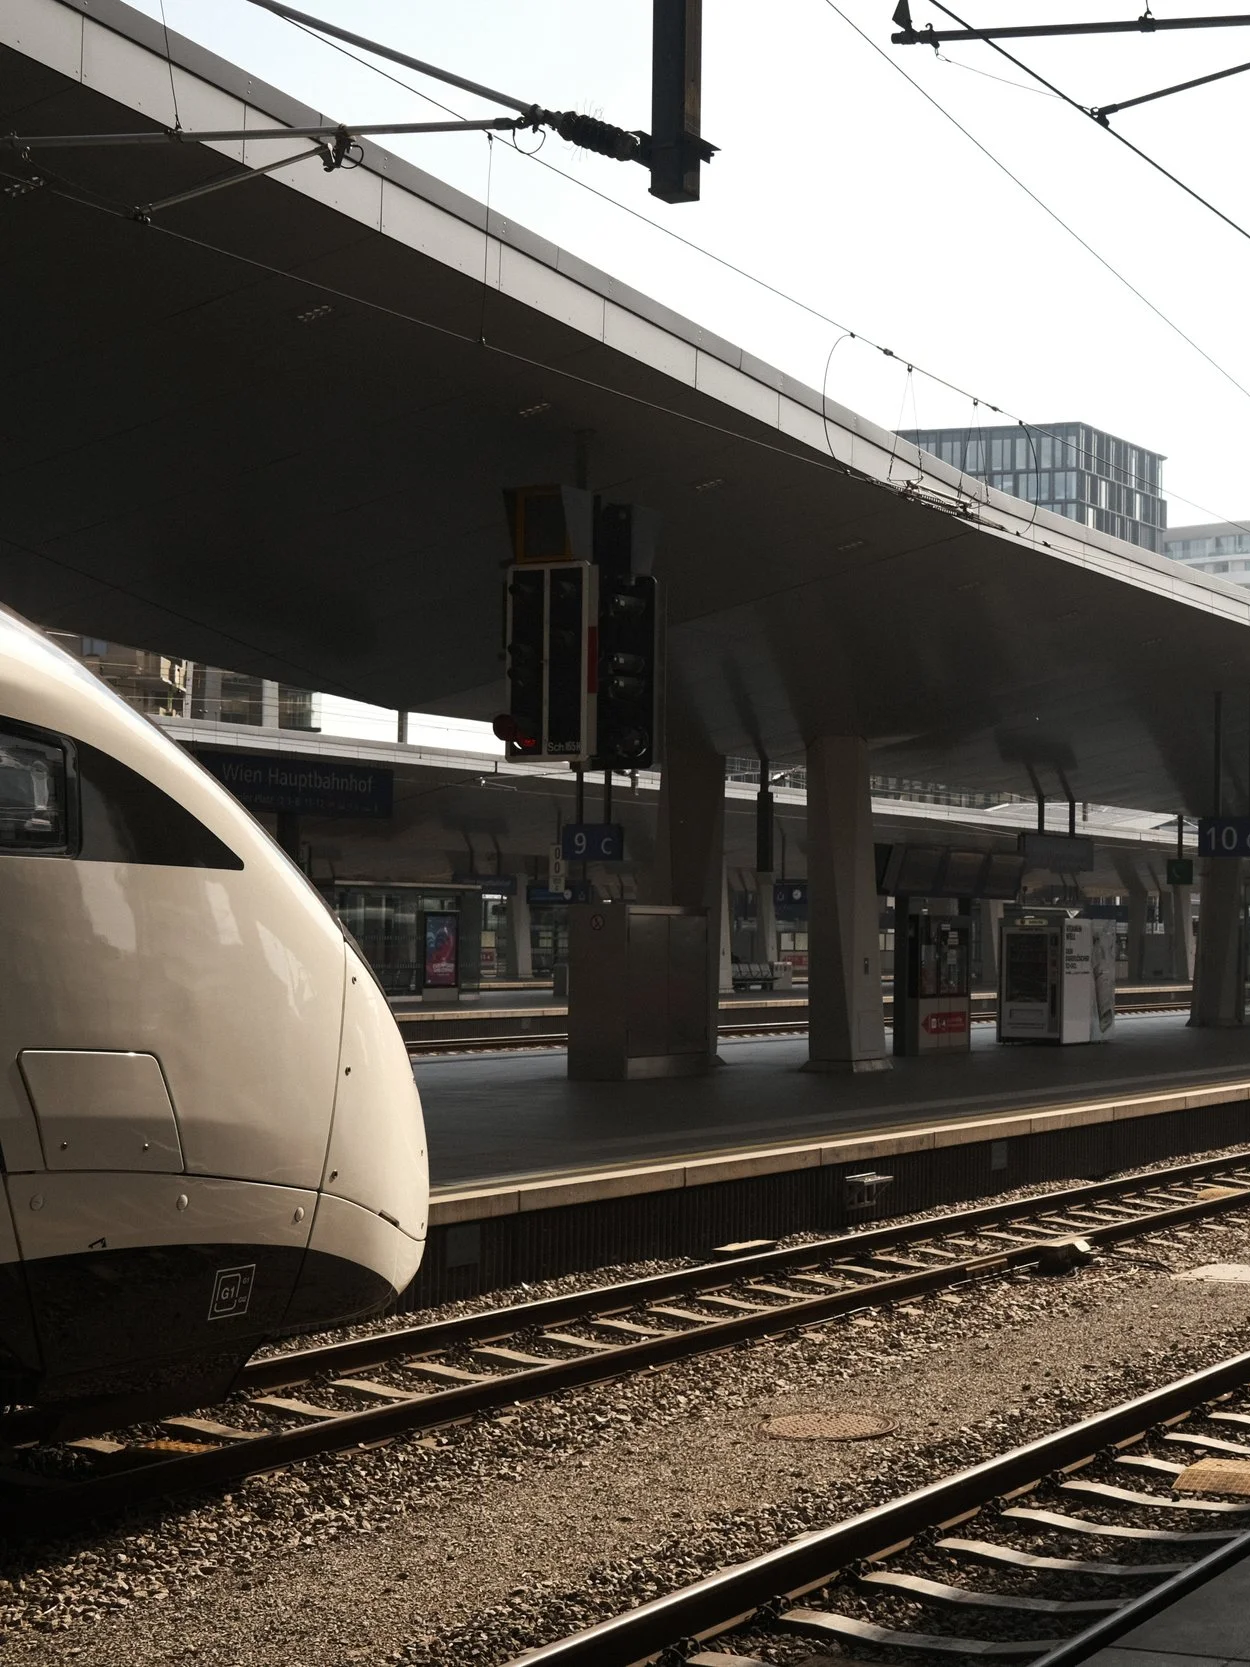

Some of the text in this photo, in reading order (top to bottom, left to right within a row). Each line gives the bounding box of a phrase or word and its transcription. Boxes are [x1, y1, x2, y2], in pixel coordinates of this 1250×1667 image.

[222, 763, 373, 793] Wien Hauptbahnhof
[574, 832, 587, 855] 9
[1206, 825, 1238, 851] 10
[221, 1285, 235, 1301] G1
